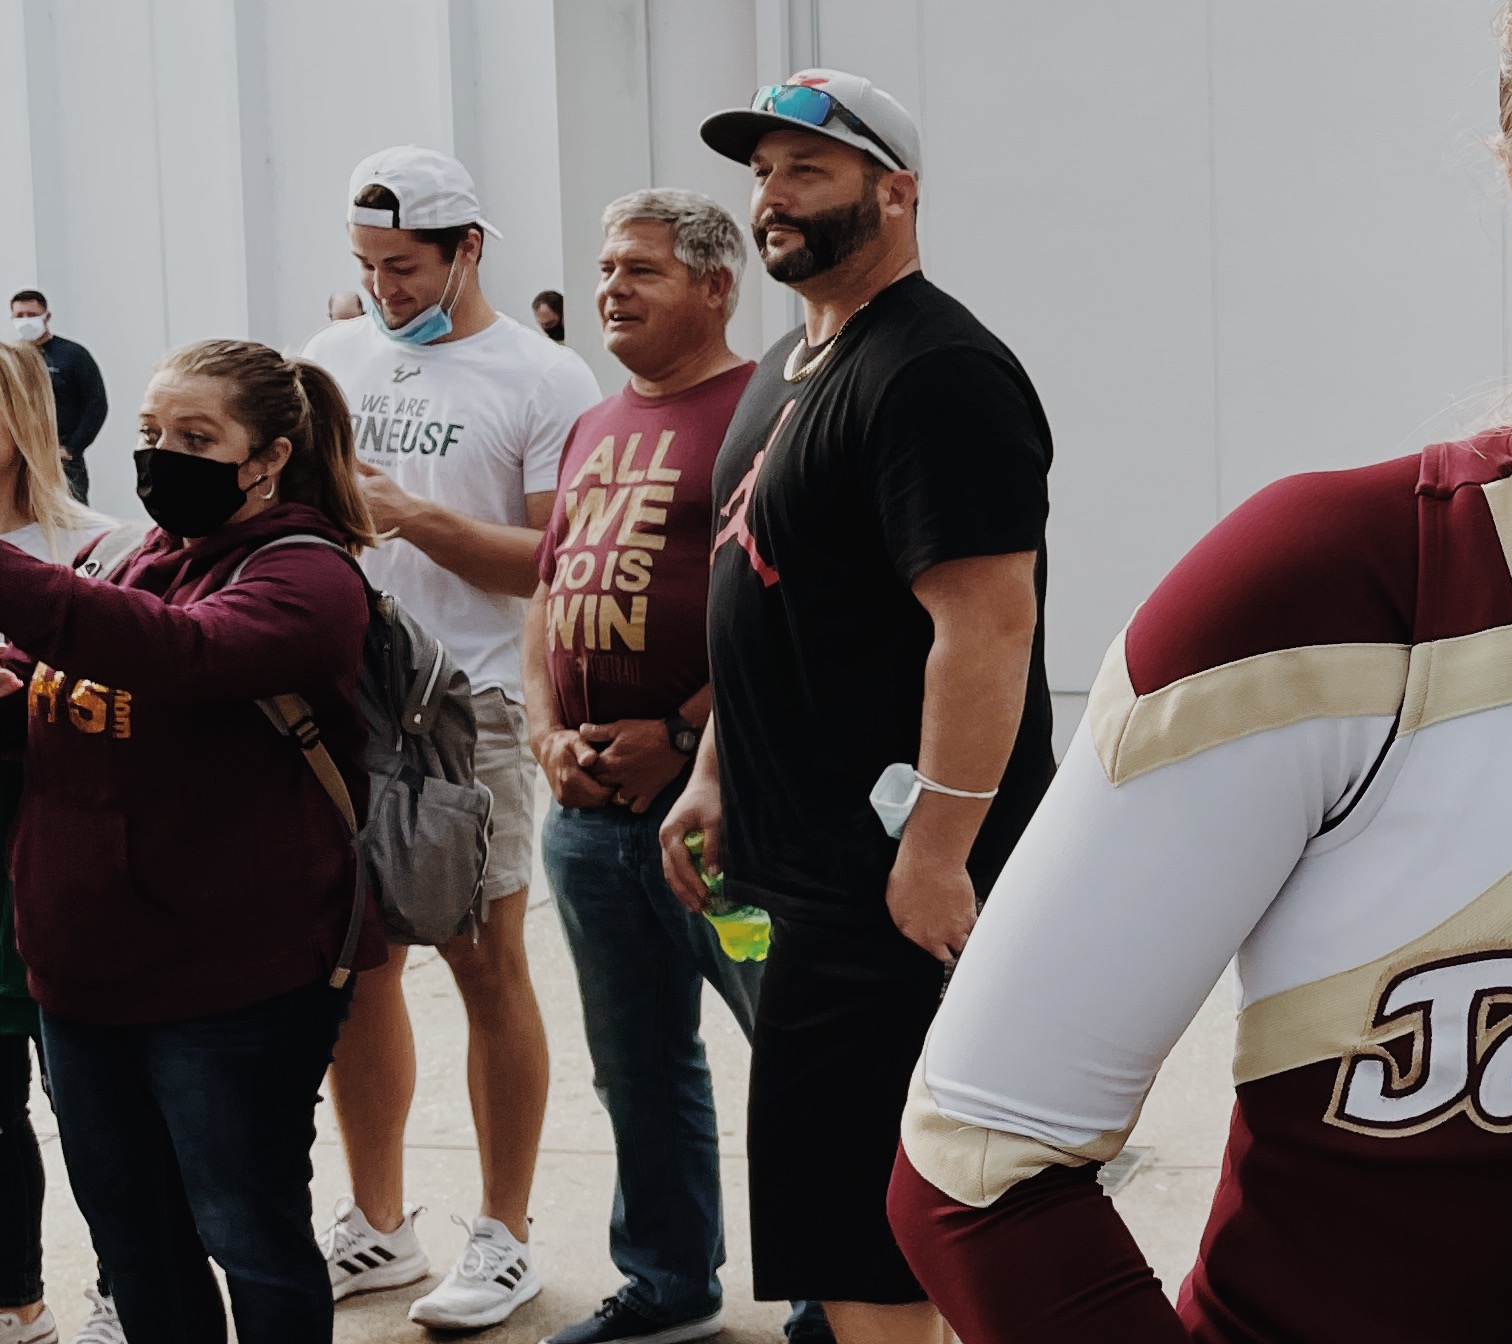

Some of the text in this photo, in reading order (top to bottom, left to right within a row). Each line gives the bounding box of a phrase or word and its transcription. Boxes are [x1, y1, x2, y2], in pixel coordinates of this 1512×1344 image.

[361, 394, 429, 417] WE ARE
[569, 430, 682, 489] ALL
[562, 484, 675, 550] WE
[601, 549, 653, 592] IS
[547, 593, 649, 652] WIN
